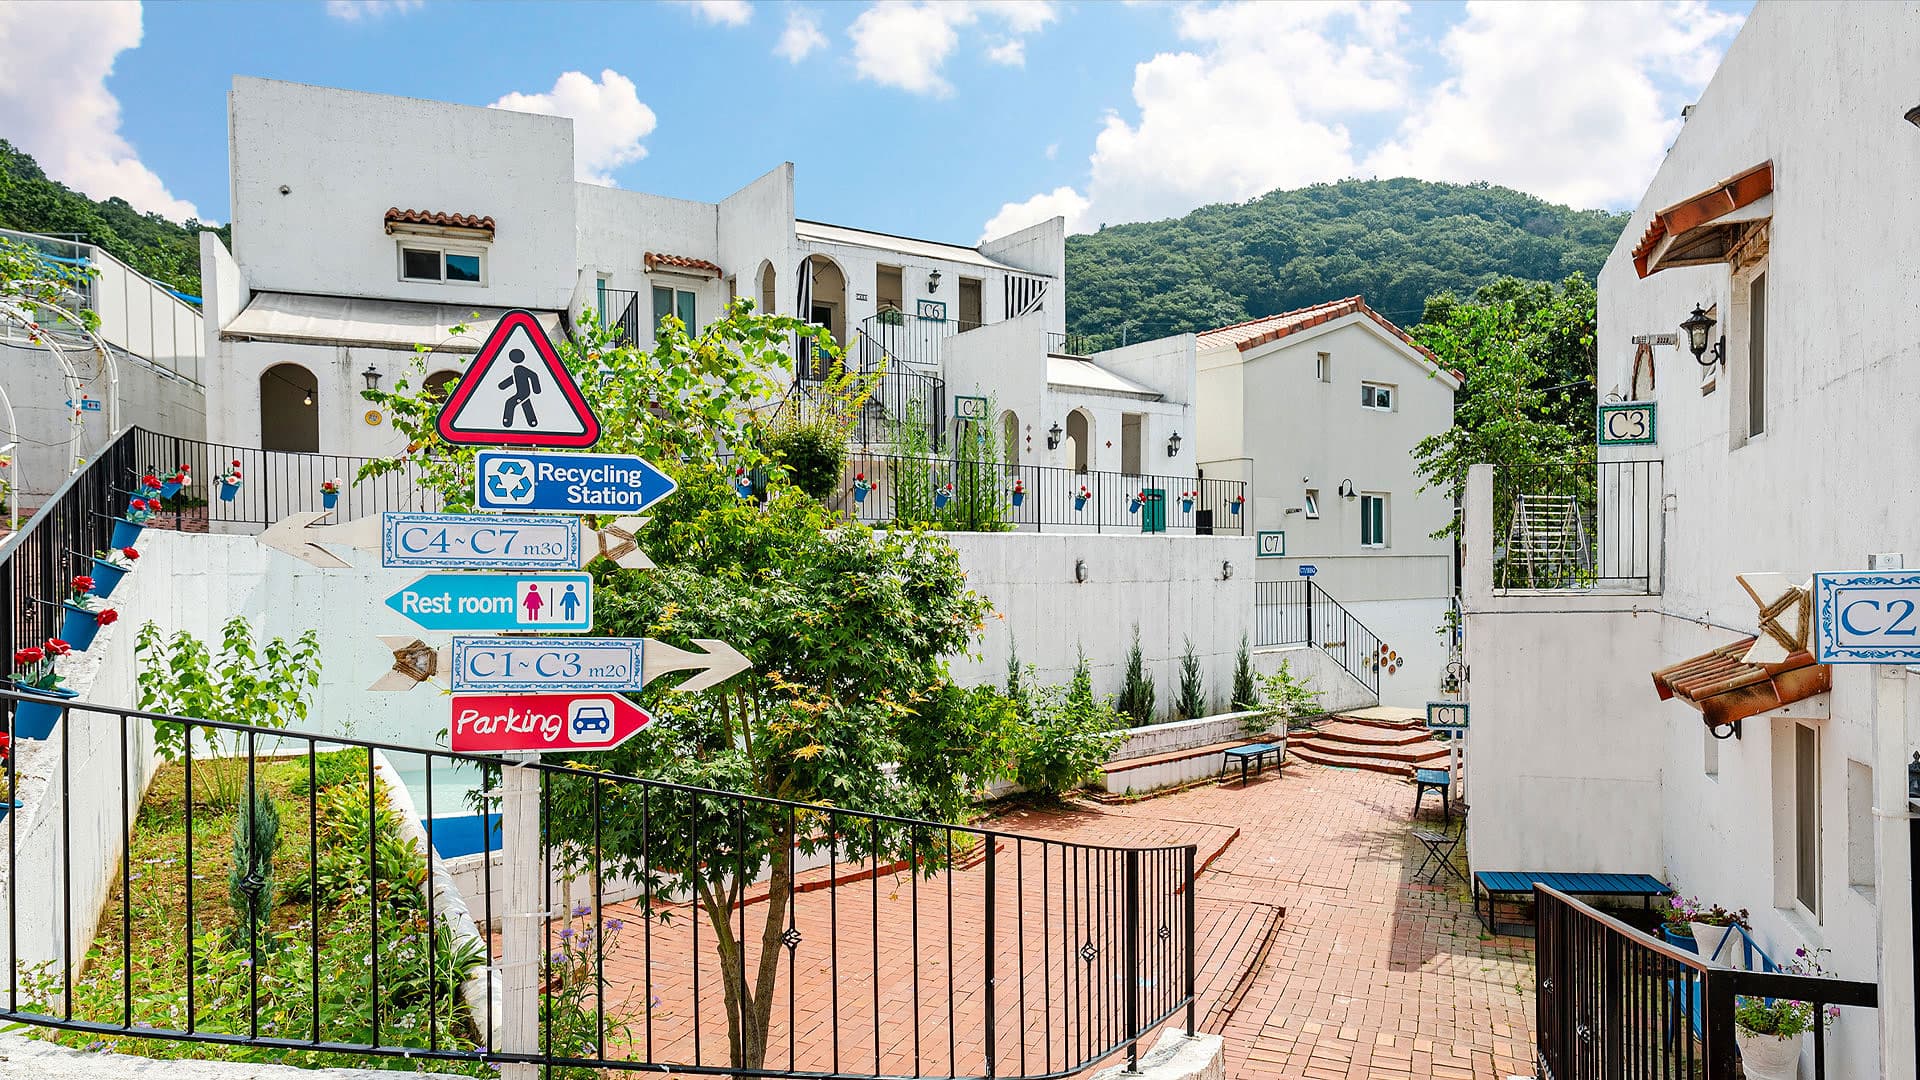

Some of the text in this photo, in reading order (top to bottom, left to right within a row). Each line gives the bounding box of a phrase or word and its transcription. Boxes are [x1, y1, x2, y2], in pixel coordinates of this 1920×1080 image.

[924, 304, 940, 320] C6
[1608, 411, 1645, 438] C3
[538, 463, 642, 487] Recycling
[567, 485, 642, 505] Station
[523, 542, 563, 555] m30
[1264, 535, 1279, 552] C7
[402, 591, 513, 613] Rest room
[1841, 600, 1917, 636] C2
[588, 664, 627, 678] m20
[456, 707, 563, 741] Parking
[1438, 707, 1457, 724] C1
